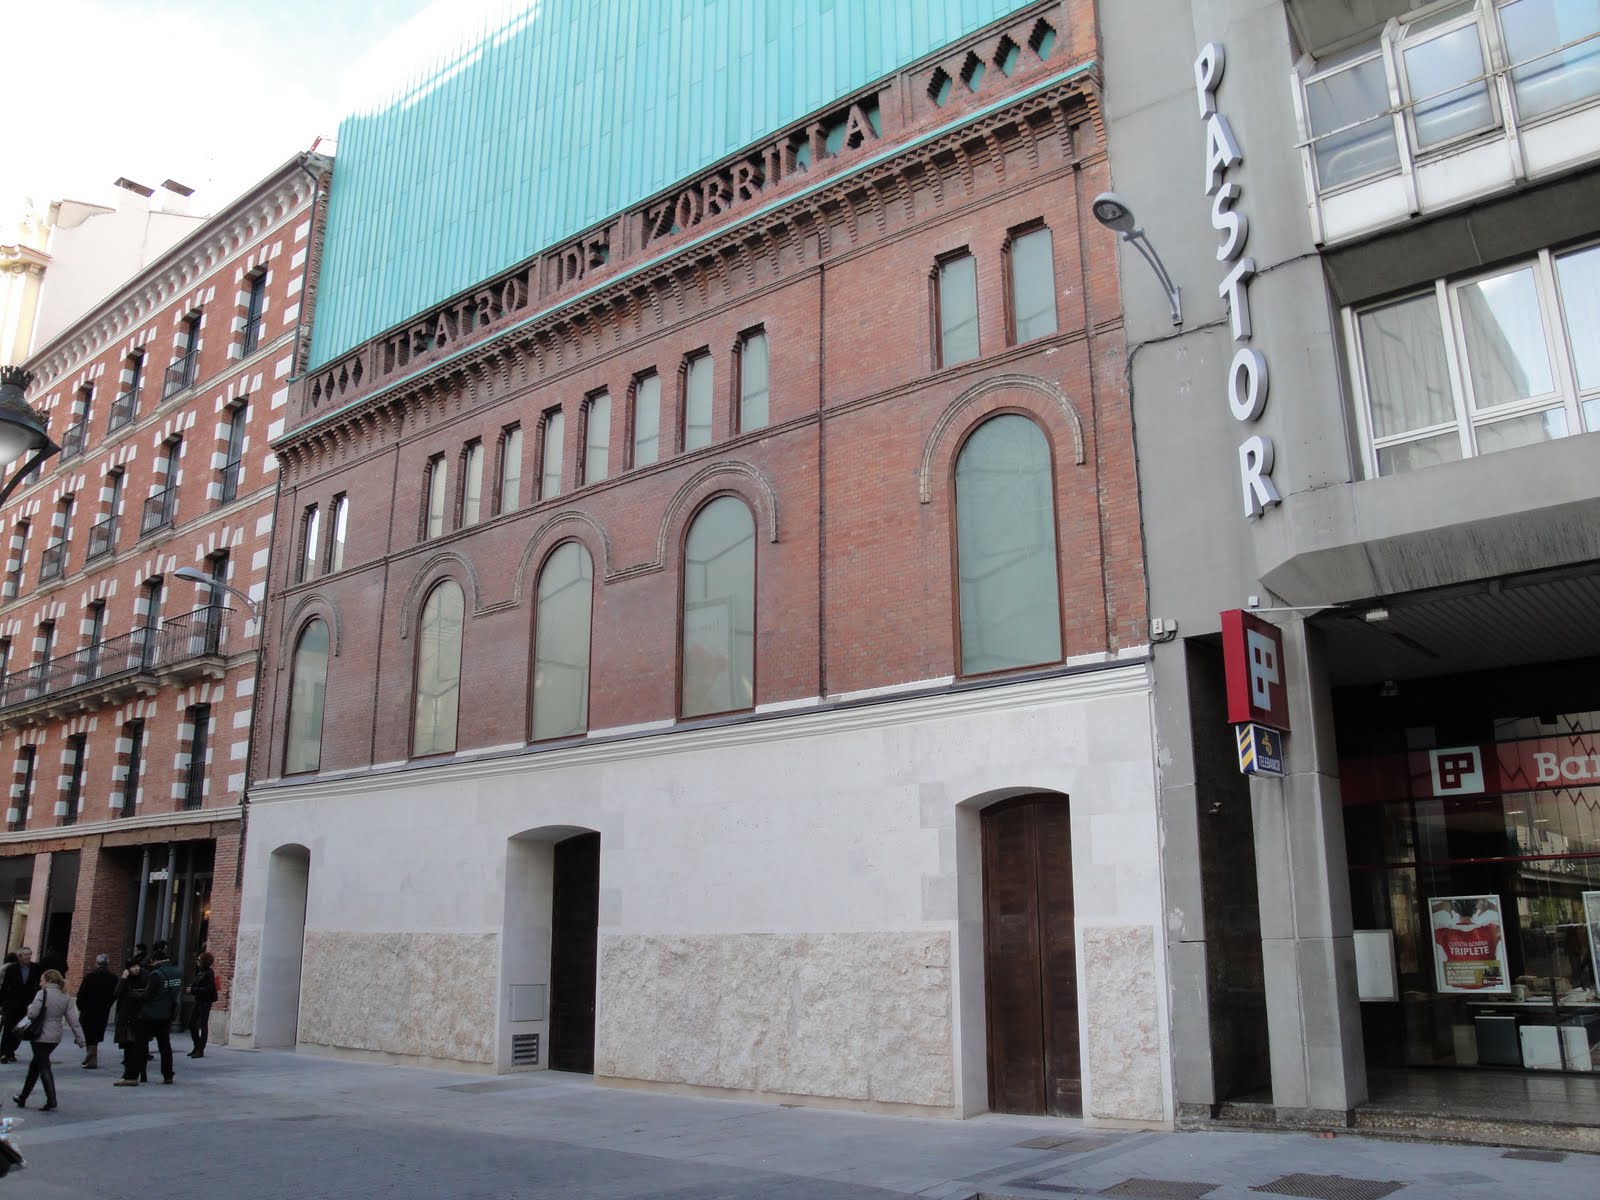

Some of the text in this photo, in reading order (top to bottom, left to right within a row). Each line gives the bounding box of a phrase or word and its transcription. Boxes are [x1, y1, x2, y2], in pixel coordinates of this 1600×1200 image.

[389, 103, 879, 370] TEATRO DE ZORRILLA
[1193, 43, 1282, 520] PASTOR
[1450, 946, 1490, 956] TRIPLETE
